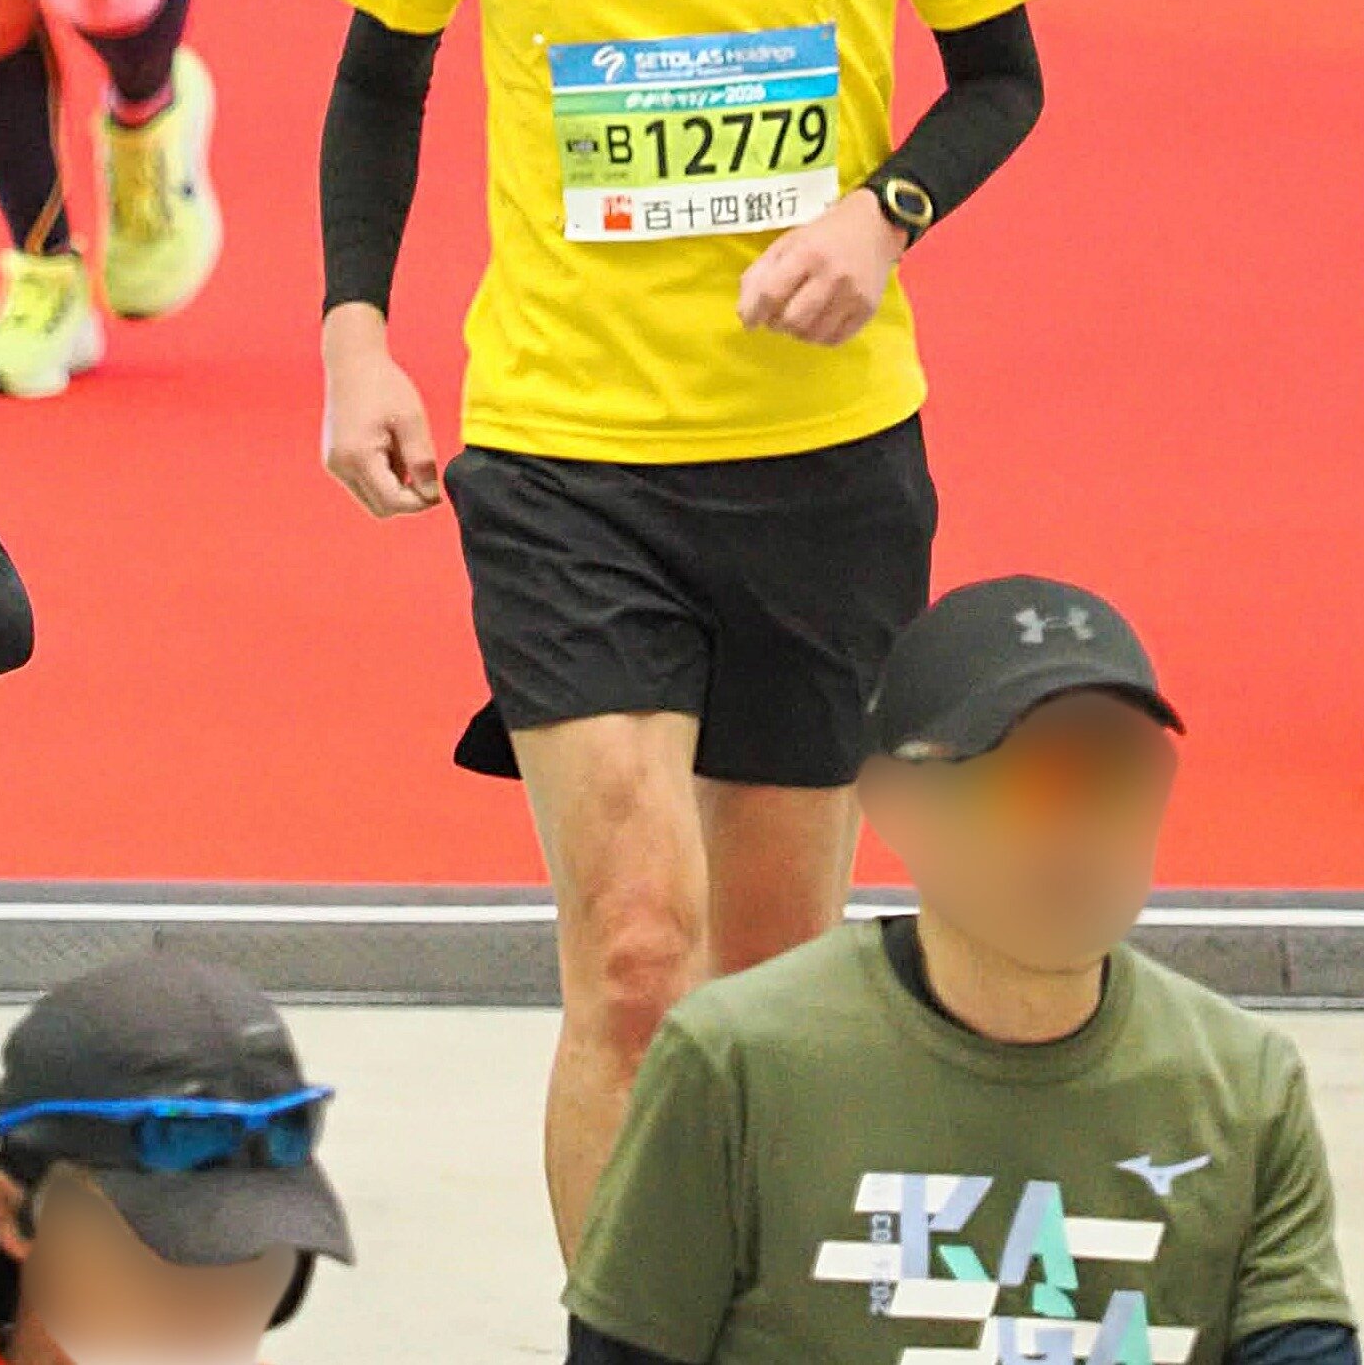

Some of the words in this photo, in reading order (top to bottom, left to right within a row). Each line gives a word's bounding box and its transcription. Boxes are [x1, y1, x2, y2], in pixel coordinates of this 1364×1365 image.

[642, 187, 800, 230] 百十四銀行
